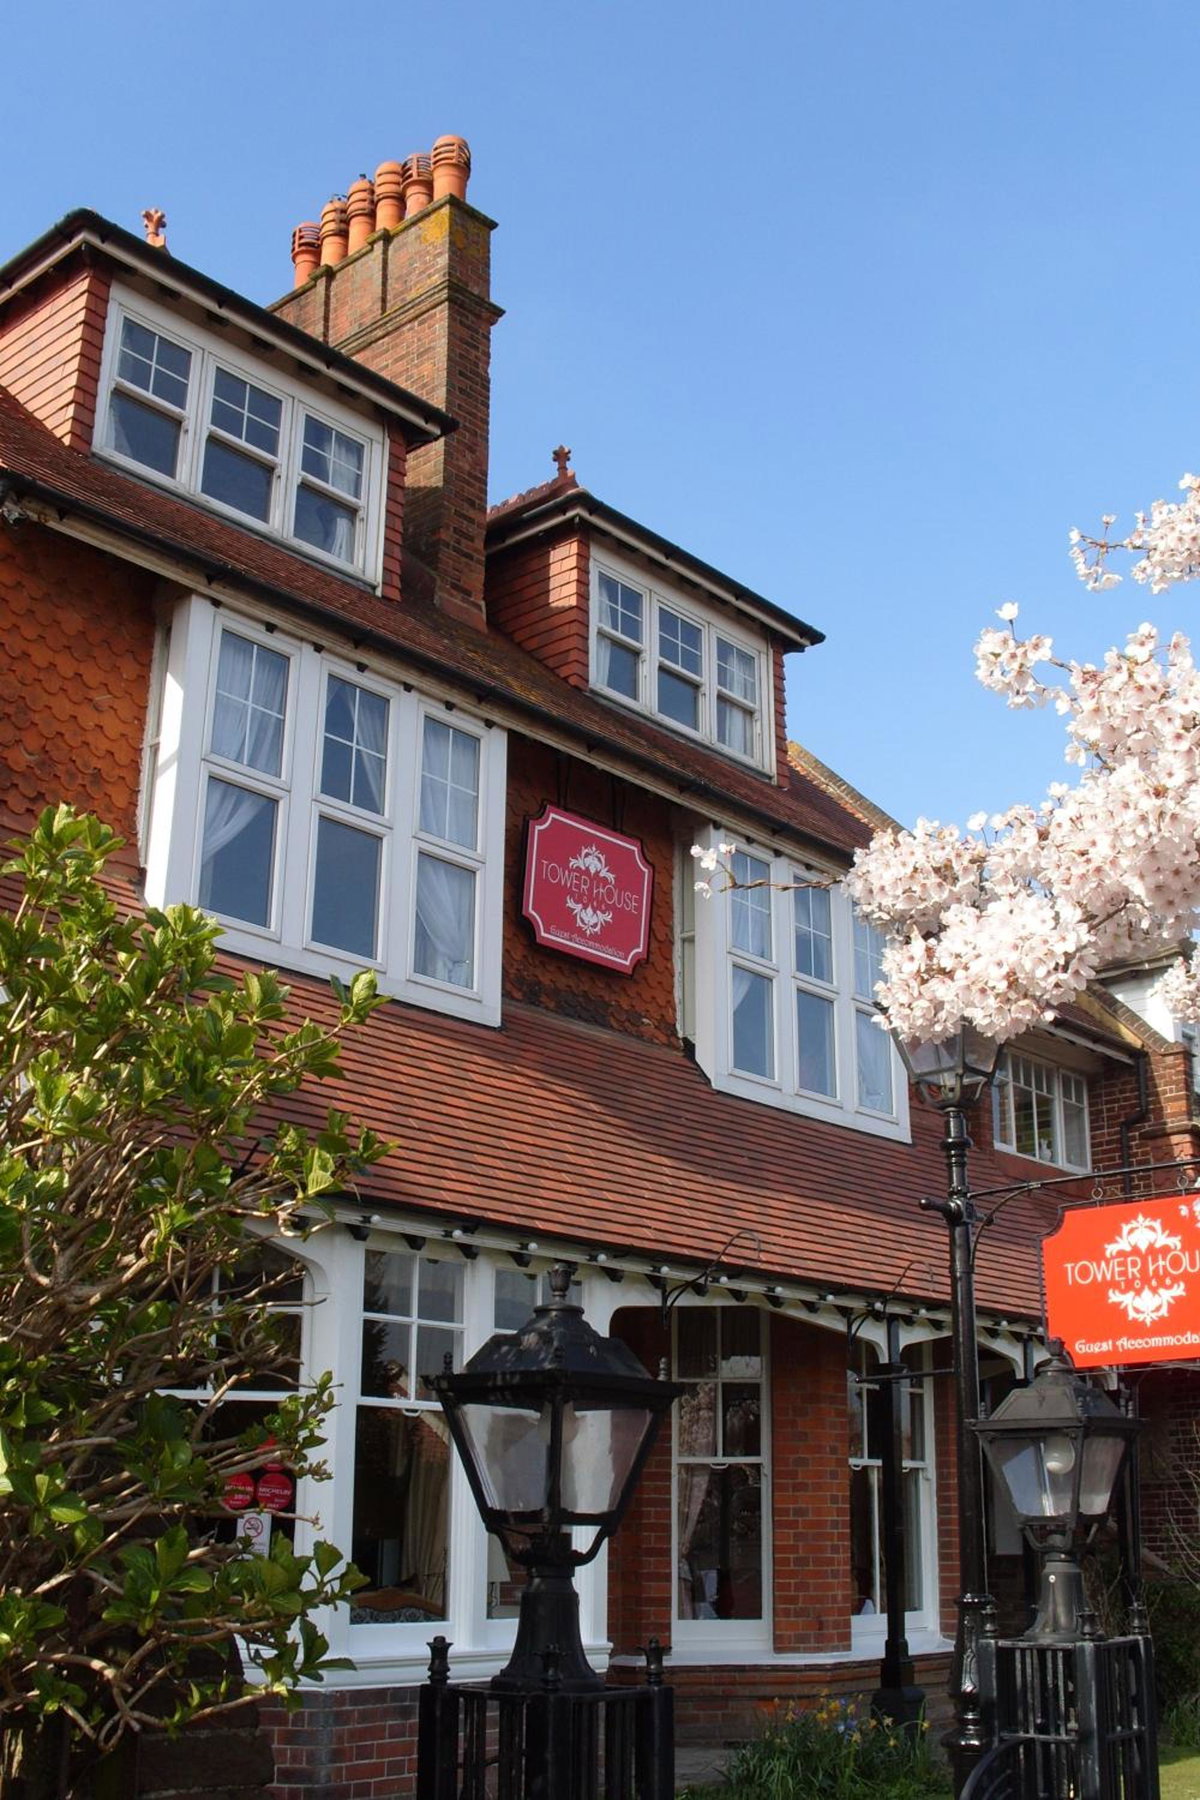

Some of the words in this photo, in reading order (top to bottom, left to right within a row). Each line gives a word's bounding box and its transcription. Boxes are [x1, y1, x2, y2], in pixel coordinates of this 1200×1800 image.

[541, 860, 590, 895] TOWER
[593, 880, 640, 914] HOUSE
[1063, 1256, 1142, 1285] TOWER
[1148, 1249, 1200, 1276] HOU
[1120, 1276, 1172, 1289] 1066
[1075, 1339, 1113, 1354] Guest
